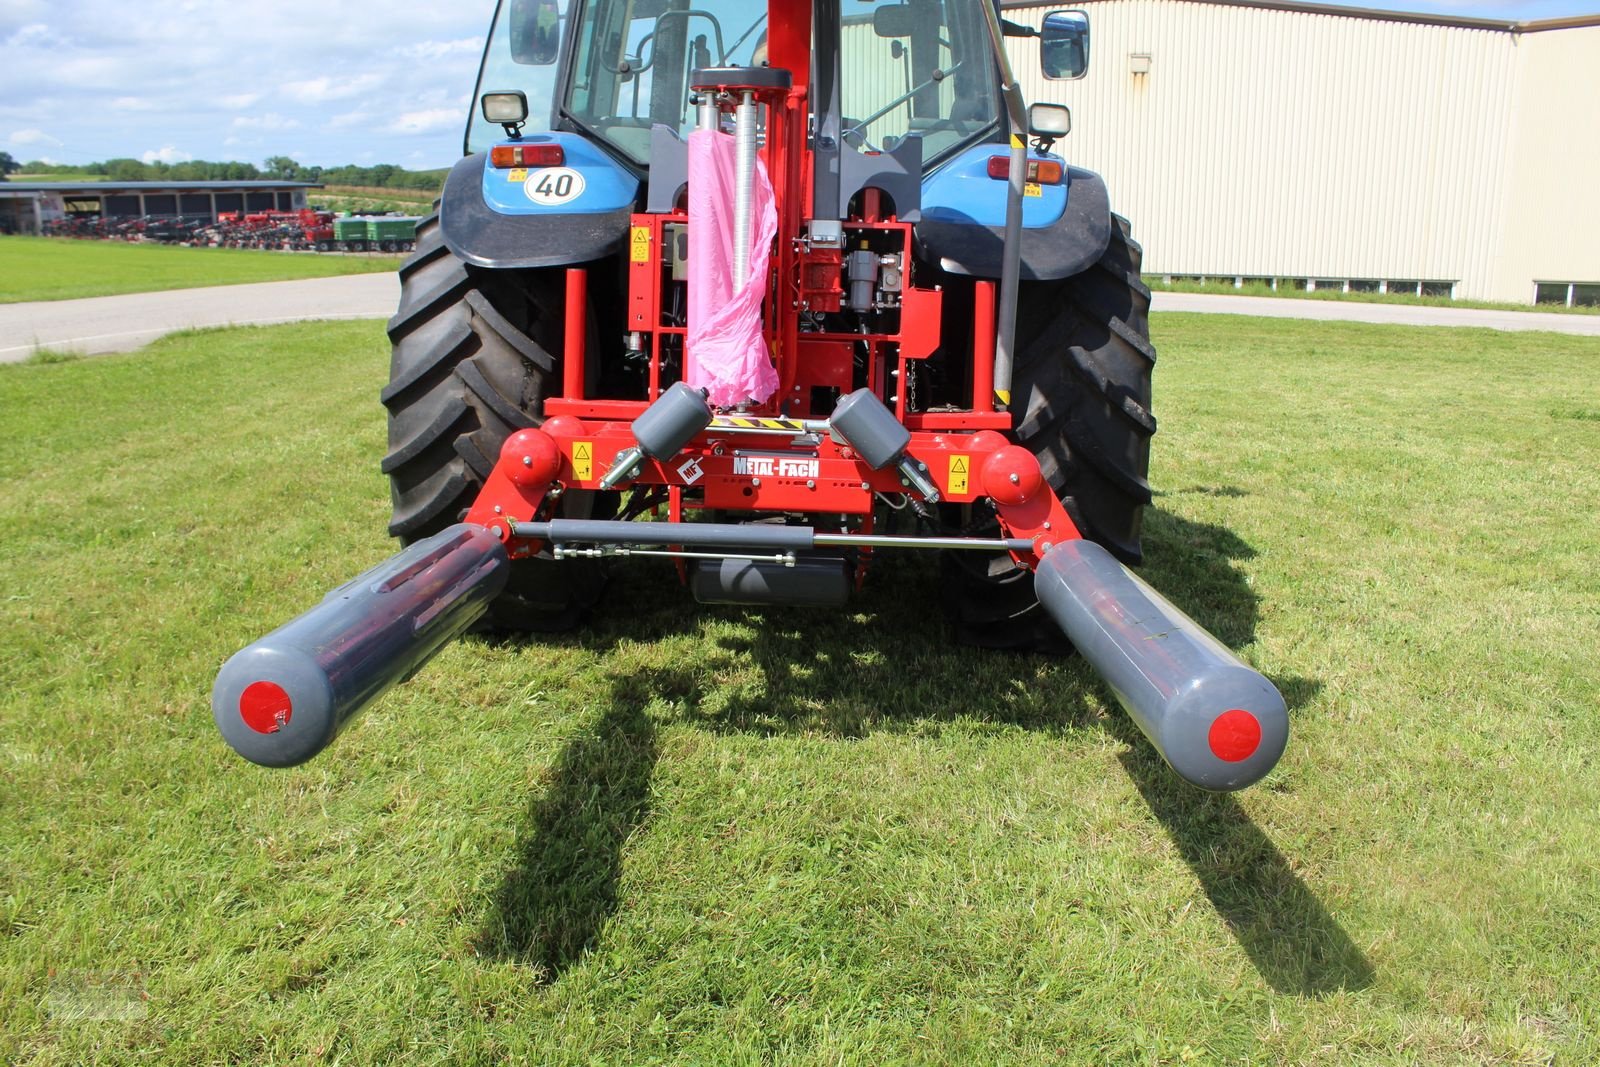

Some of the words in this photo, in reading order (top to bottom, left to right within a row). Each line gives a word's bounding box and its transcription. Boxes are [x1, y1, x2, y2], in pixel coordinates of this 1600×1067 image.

[535, 174, 574, 197] 40
[682, 465, 698, 479] MF
[733, 456, 820, 478] METAL-FACH
